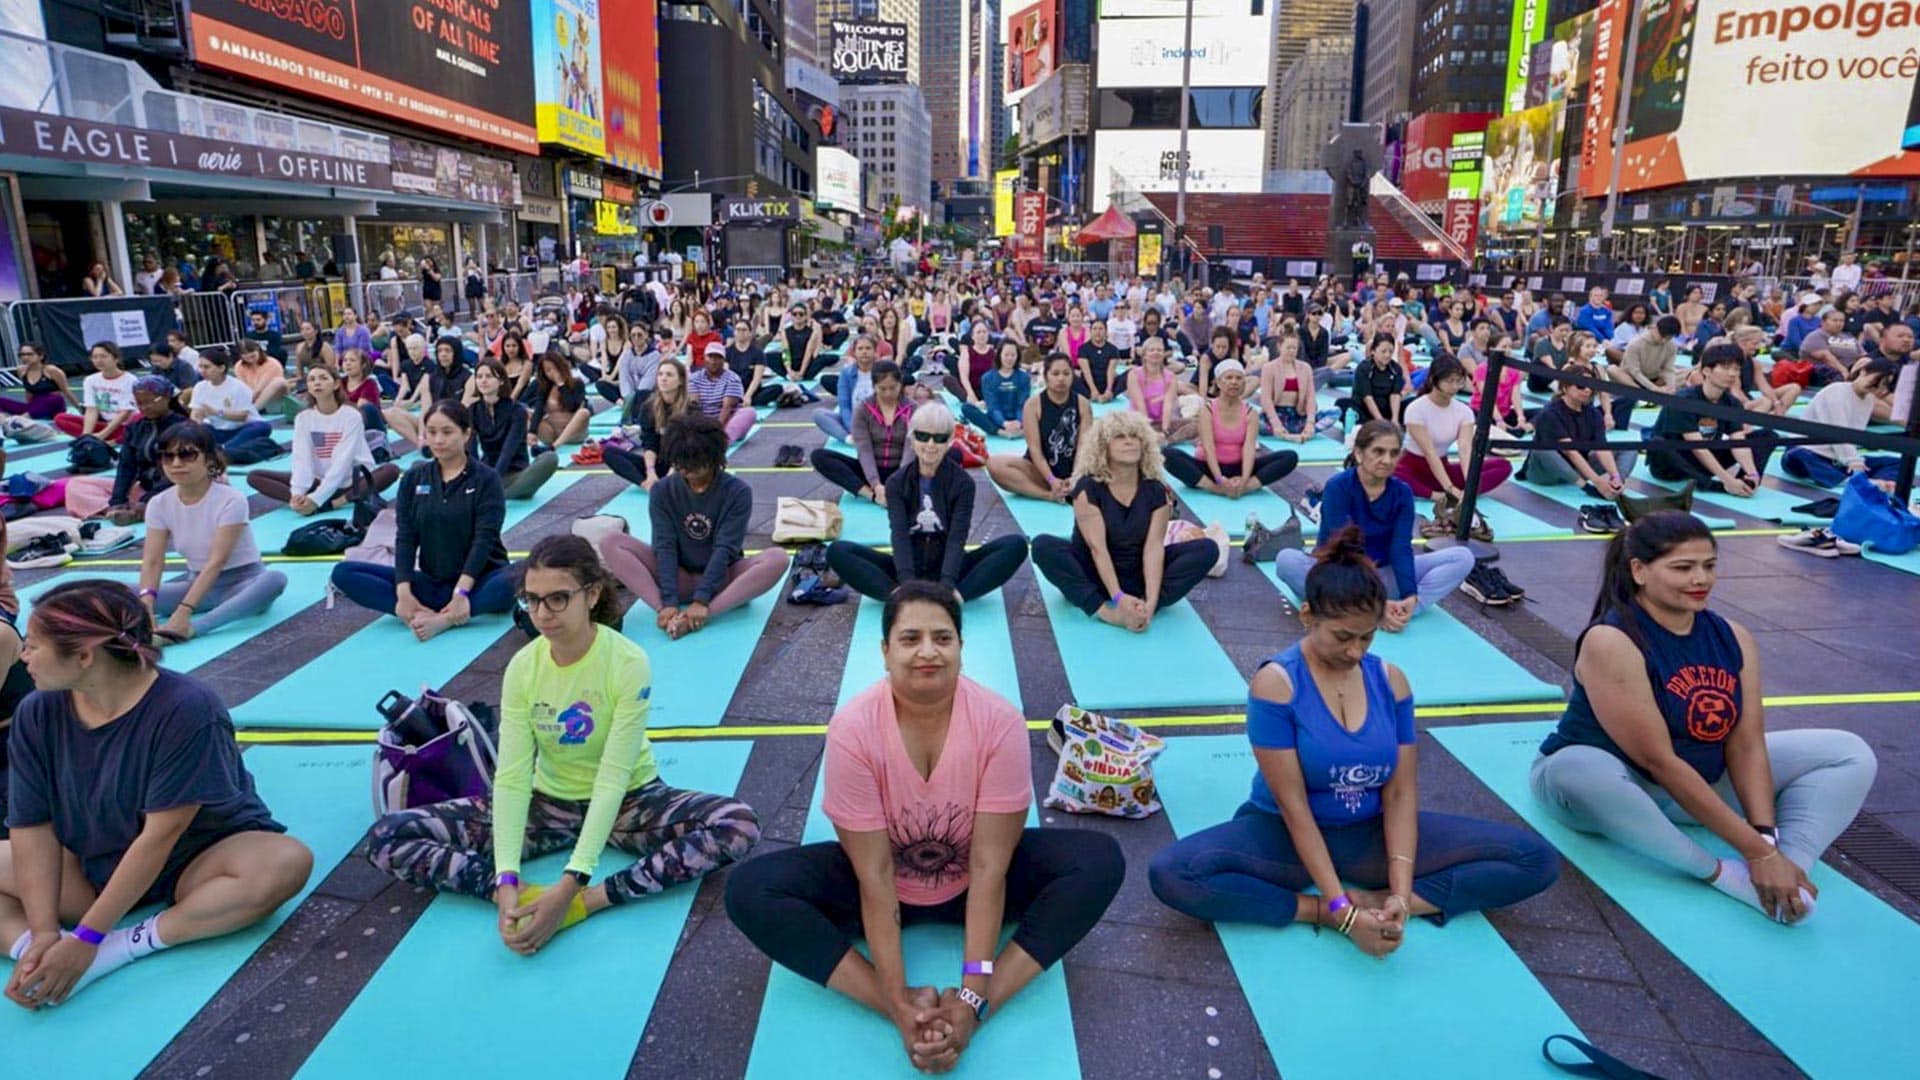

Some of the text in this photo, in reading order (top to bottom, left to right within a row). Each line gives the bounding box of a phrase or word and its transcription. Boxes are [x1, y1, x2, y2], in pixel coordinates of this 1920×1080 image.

[238, 0, 346, 40] CAGO
[411, 5, 434, 33] OF
[439, 18, 464, 48] ALL
[427, 0, 491, 33] SICALS
[833, 21, 905, 37] WELCOME TO
[832, 48, 908, 73] SQUARE
[863, 39, 905, 58] TIMES
[1162, 48, 1206, 58] inded
[307, 66, 350, 90] THEATRE
[1746, 47, 1919, 85] feito você
[33, 120, 152, 162] EAGLE
[198, 146, 242, 171] aerie
[278, 155, 368, 184] OFFLINE
[729, 202, 790, 217] KLIKTIX
[1023, 195, 1043, 234] tkts
[1452, 202, 1475, 244] tkts
[1666, 665, 1737, 700] PRINCETON
[1094, 760, 1132, 777] INDIA
